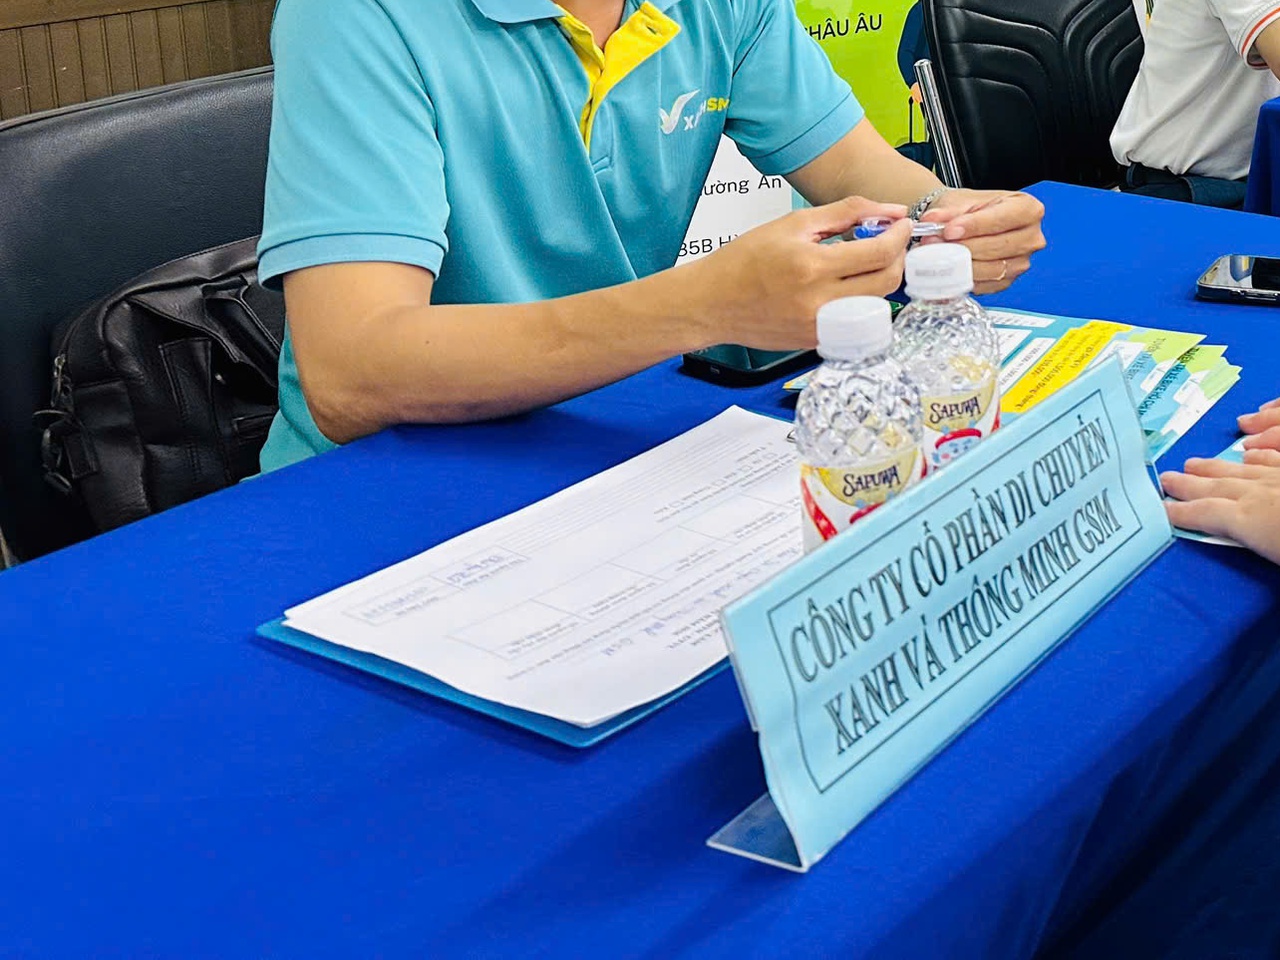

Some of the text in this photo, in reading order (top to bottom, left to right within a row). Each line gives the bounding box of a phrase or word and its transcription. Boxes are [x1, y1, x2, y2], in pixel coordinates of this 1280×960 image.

[803, 12, 883, 41] HÂU ÂU
[706, 96, 730, 112] SM
[700, 179, 749, 196] ường
[930, 396, 981, 424] SAPUWA
[842, 464, 901, 497] SAPUWA
[790, 597, 875, 684] CÔNG
[868, 558, 910, 626] TY
[910, 520, 947, 598] CỔ
[942, 487, 1011, 574] PHẦN
[1004, 472, 1036, 529] DI
[1032, 414, 1111, 508] CHUYỂN
[823, 487, 1123, 756] XANH VÀ THÔNG MINH GSM
